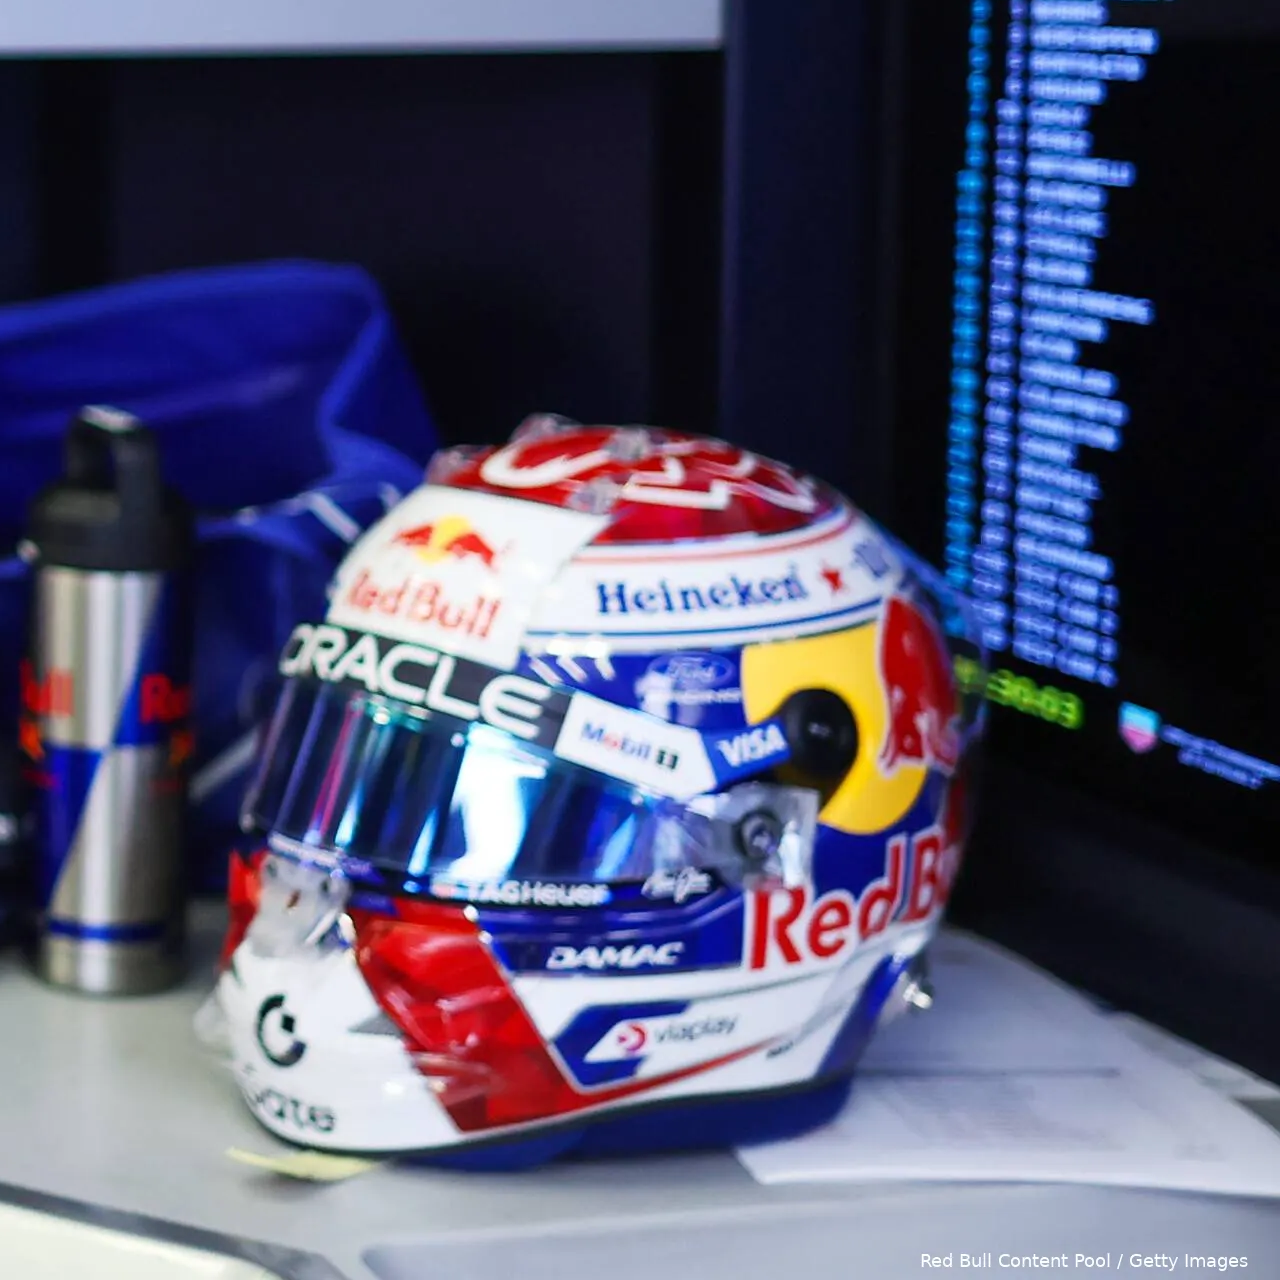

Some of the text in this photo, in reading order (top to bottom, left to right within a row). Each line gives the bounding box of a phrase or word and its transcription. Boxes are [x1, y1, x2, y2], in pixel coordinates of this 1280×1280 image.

[596, 565, 811, 613] Heineken
[580, 720, 652, 759] Mobil
[717, 724, 789, 768] VISA
[546, 941, 685, 970] DAMAC
[655, 1014, 740, 1045] viaplay
